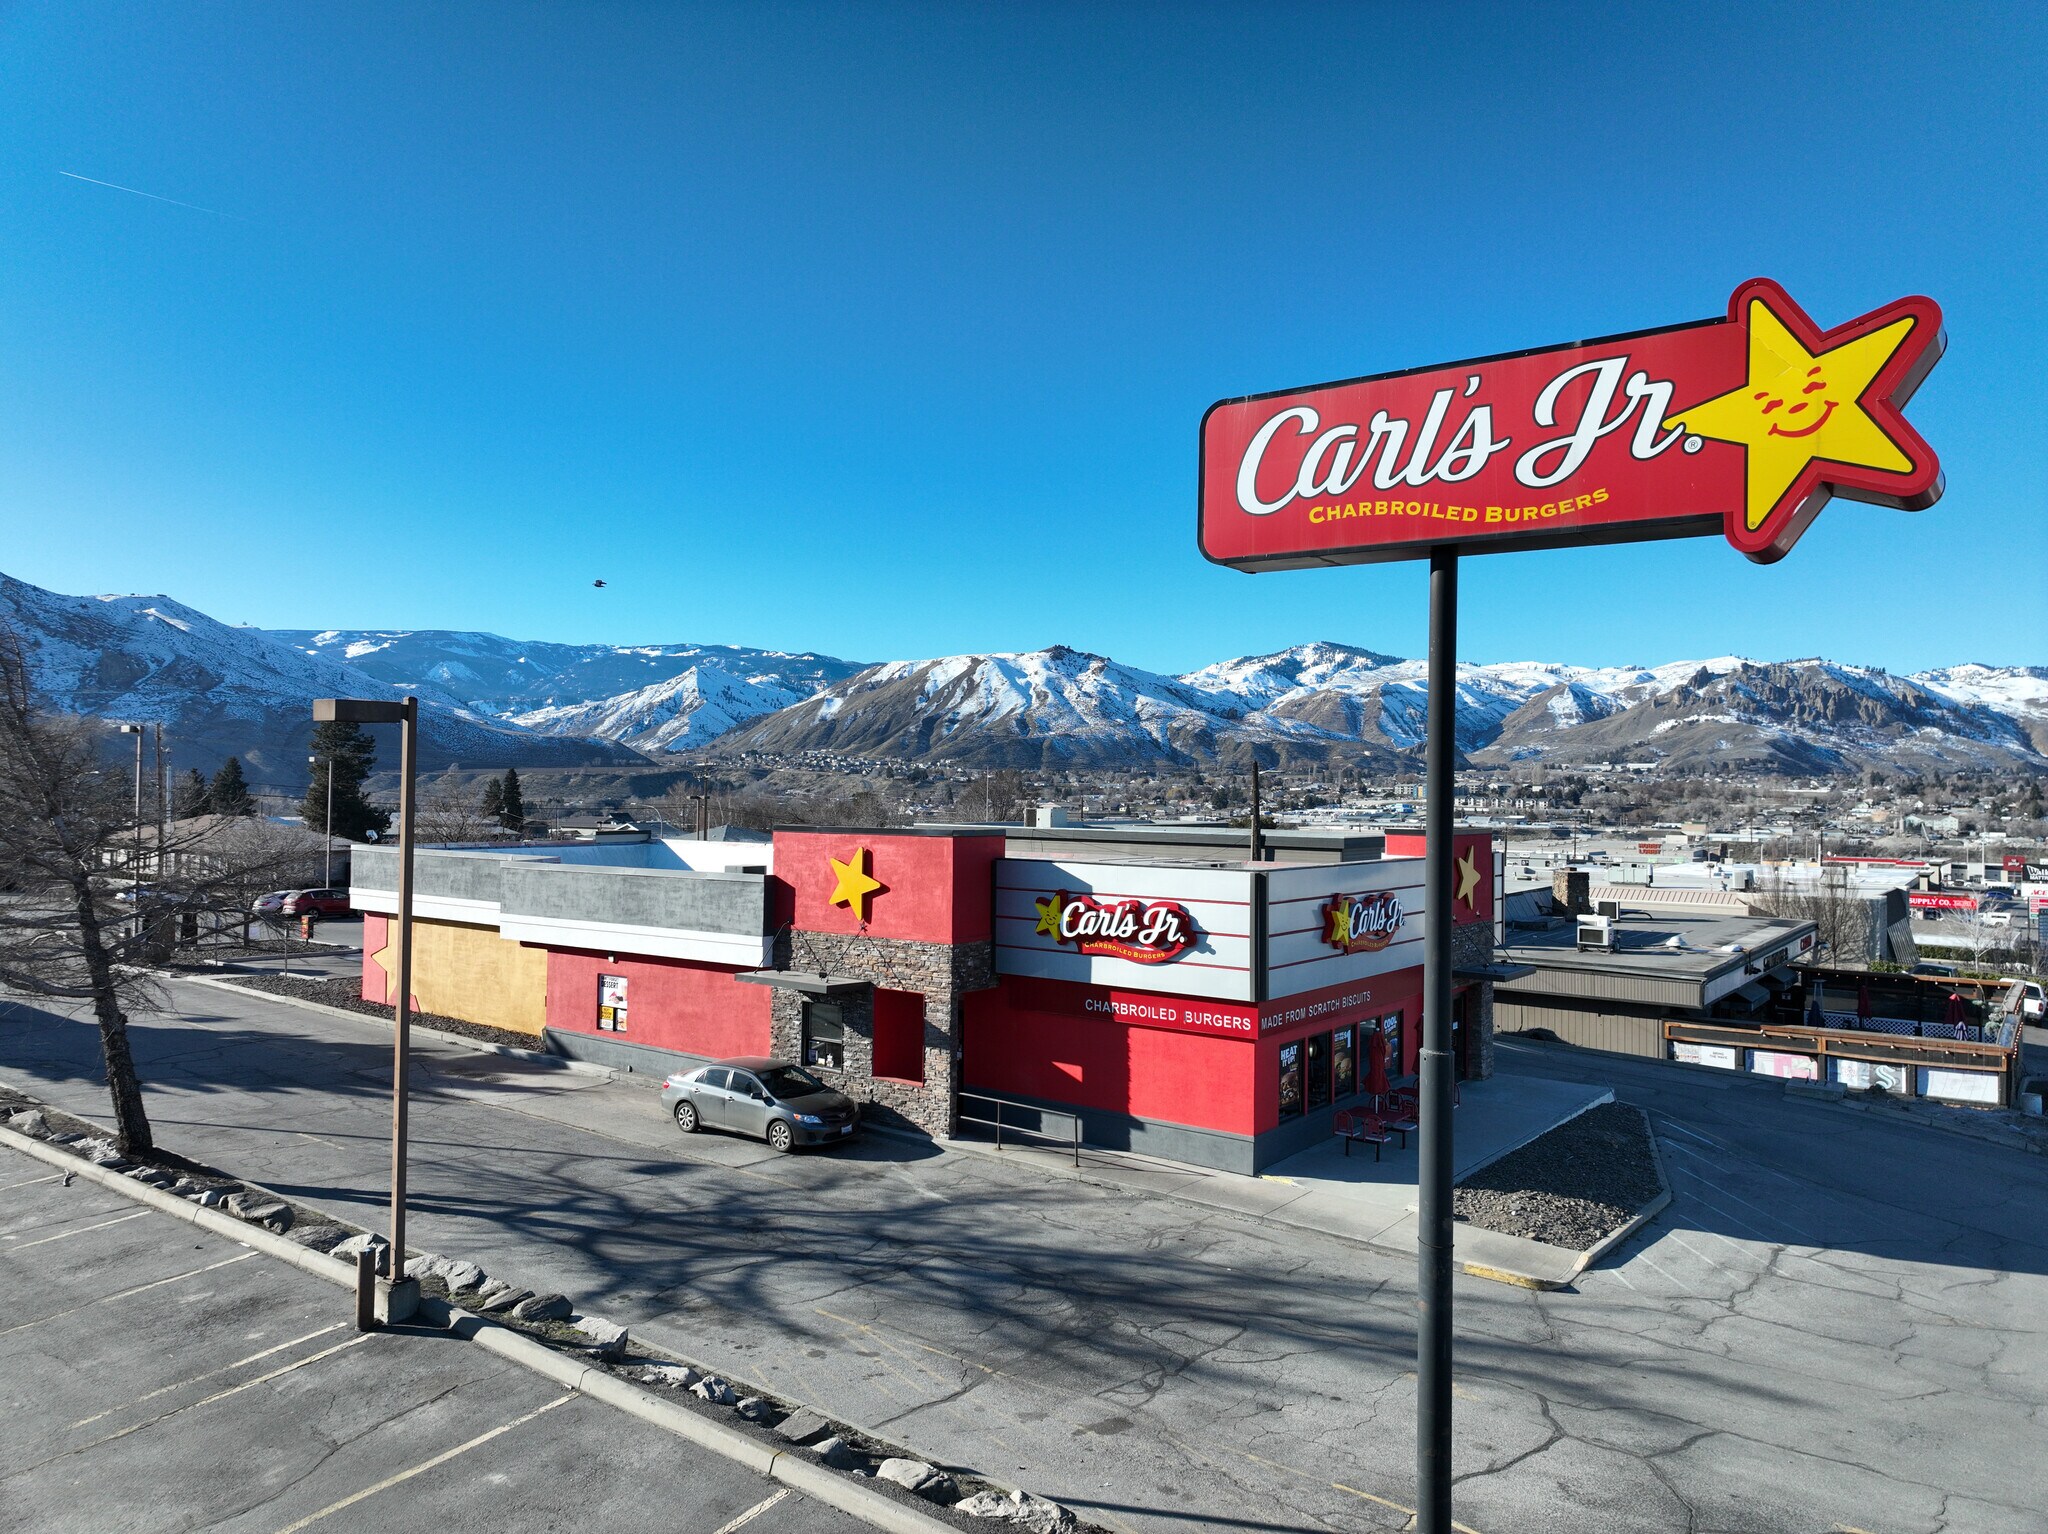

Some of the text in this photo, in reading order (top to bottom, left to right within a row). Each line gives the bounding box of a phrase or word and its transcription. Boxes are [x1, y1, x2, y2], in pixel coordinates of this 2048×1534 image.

[1236, 355, 1703, 515] Carl's Jr.
[1309, 488, 1609, 524] CHARBROILED BURGERS
[1062, 902, 1186, 944] Carl's Jr.
[1350, 898, 1407, 939] Carl's Jr.
[1084, 941, 1165, 960] CHARBROILED BURGERS
[1085, 999, 1251, 1031] CHARBROILED BURGERS
[1261, 991, 1371, 1031] MADE FROM SCRATCH BISCUITS
[1280, 1045, 1298, 1060] HEAT
